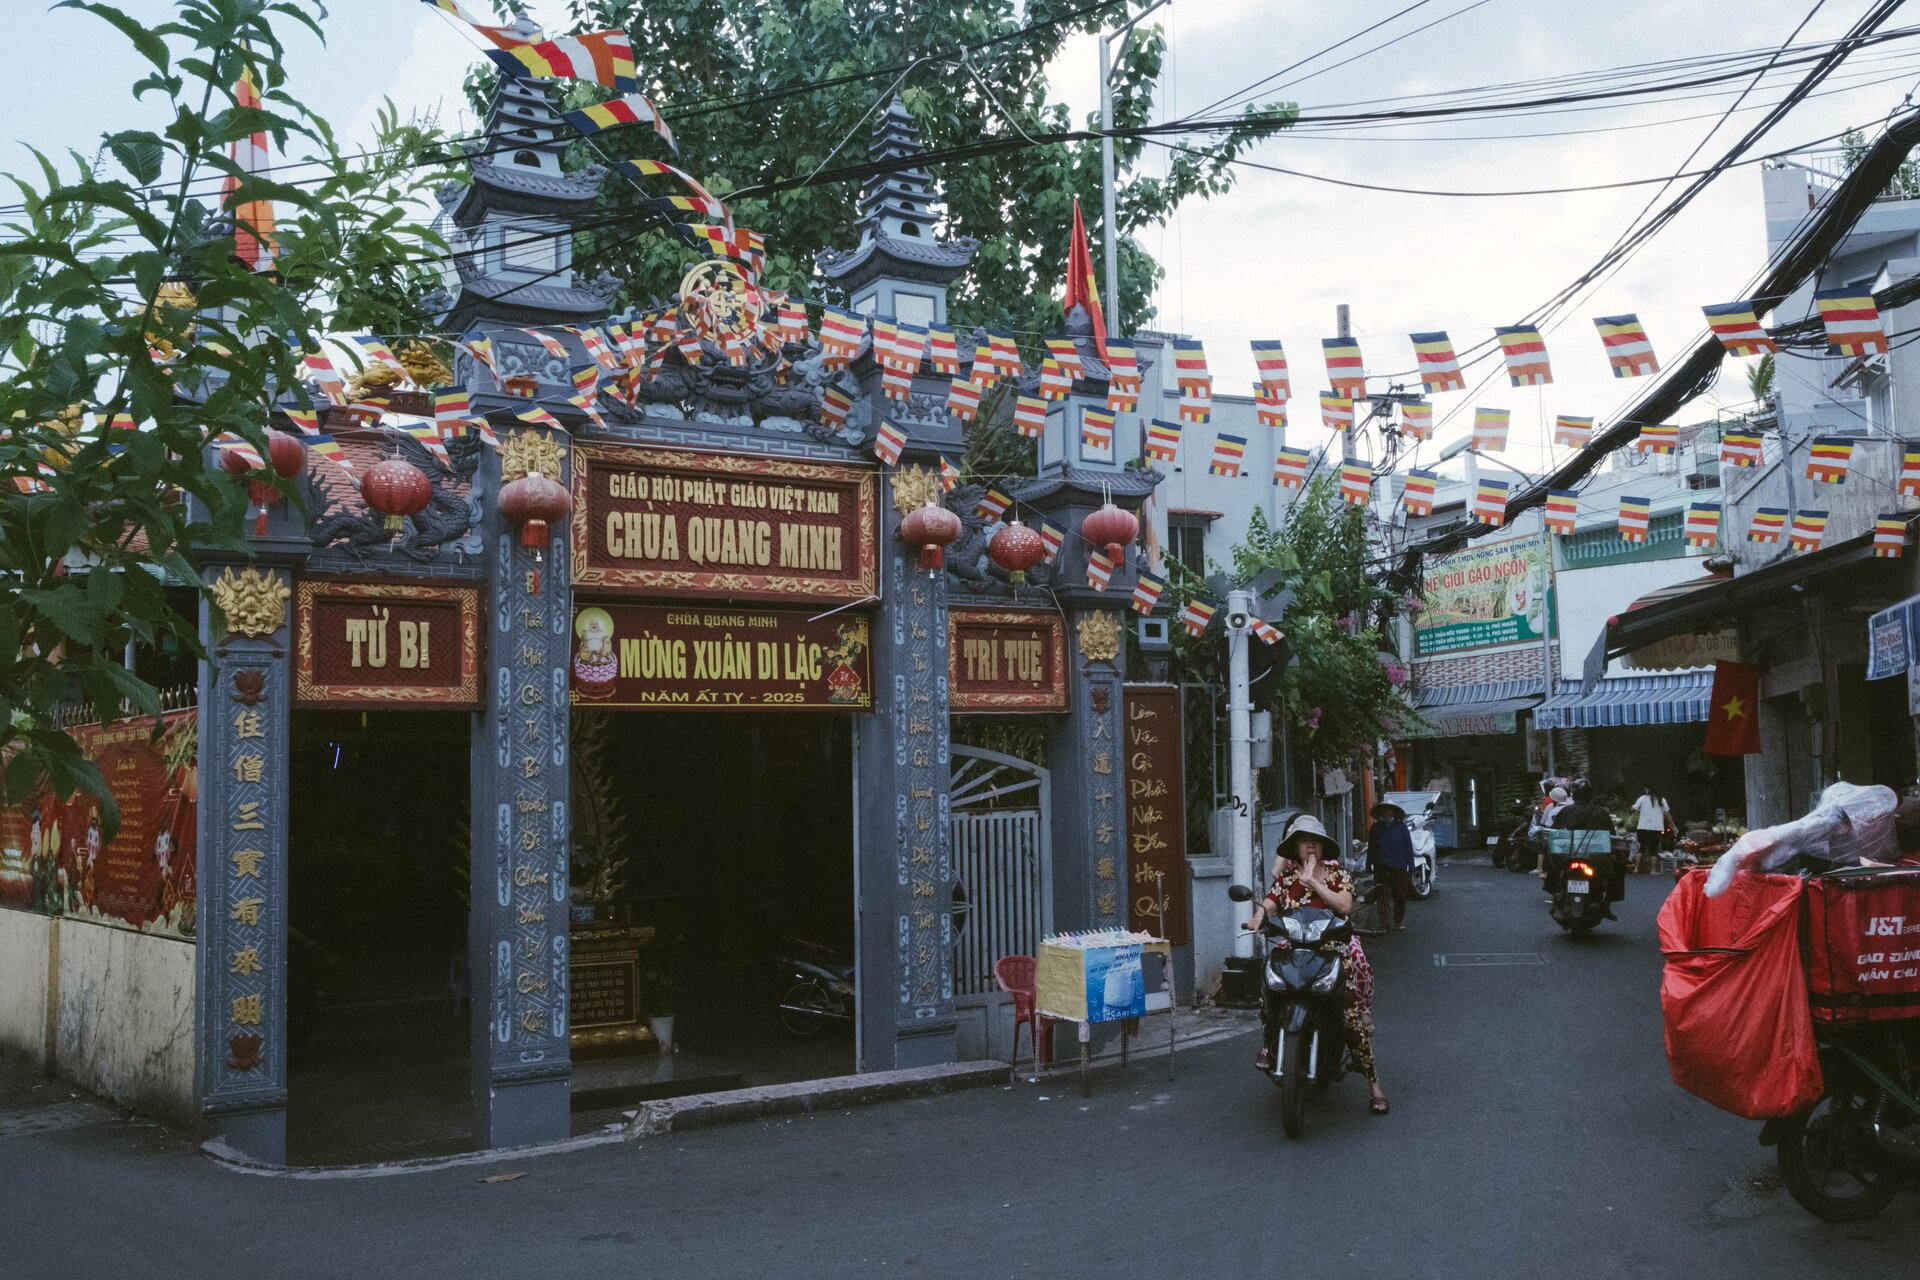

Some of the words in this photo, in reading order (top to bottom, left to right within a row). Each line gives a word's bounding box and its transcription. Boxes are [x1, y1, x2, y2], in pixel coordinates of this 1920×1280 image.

[609, 472, 649, 499] GIÁO
[651, 475, 681, 506] HỘI
[683, 478, 726, 509] PHẬT
[730, 481, 767, 509] GIÁO
[768, 485, 805, 515] VIỆT
[807, 490, 839, 514] NAM
[606, 500, 680, 561] CHÙA
[687, 516, 772, 567] QUANG
[779, 522, 842, 571] MINH
[345, 605, 390, 668] TỪ
[399, 620, 430, 669] BI
[667, 612, 700, 626] CHÙA
[704, 615, 745, 628] QUANG
[748, 616, 778, 628] MINH
[619, 630, 687, 679] MỪNG
[693, 632, 751, 680] XUÂN
[757, 641, 778, 680] DI
[784, 635, 822, 689] LẶC
[963, 629, 998, 681] TRÍ
[1004, 631, 1043, 688] TUỆ
[641, 690, 690, 702] NĂM
[695, 688, 718, 702] ẤT
[763, 692, 805, 703] 2025
[1130, 701, 1158, 721] Làm
[1864, 916, 1906, 936] J&T
